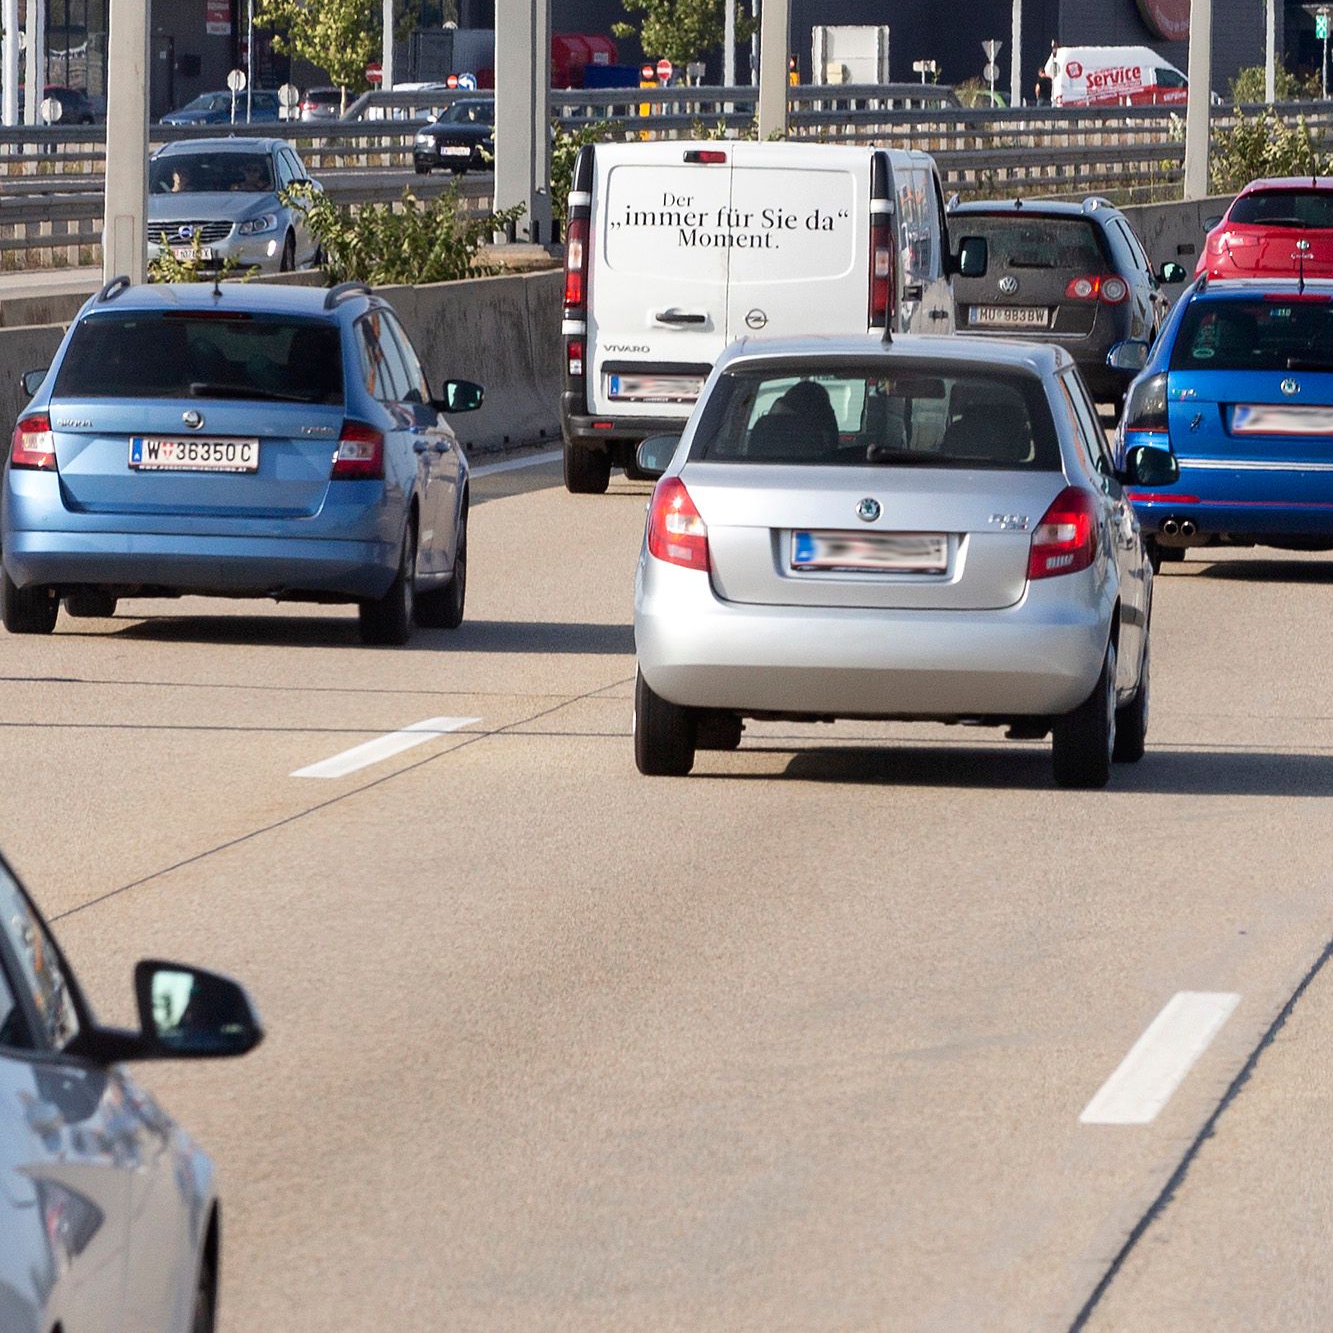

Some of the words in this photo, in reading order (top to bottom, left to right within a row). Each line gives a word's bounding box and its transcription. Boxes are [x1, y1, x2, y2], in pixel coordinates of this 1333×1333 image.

[662, 192, 694, 208] Der
[716, 206, 754, 230] für
[761, 207, 798, 231] Sie
[678, 228, 780, 249] Moment.
[146, 442, 160, 460] W
[176, 442, 236, 462] 36350
[241, 444, 251, 463] C
